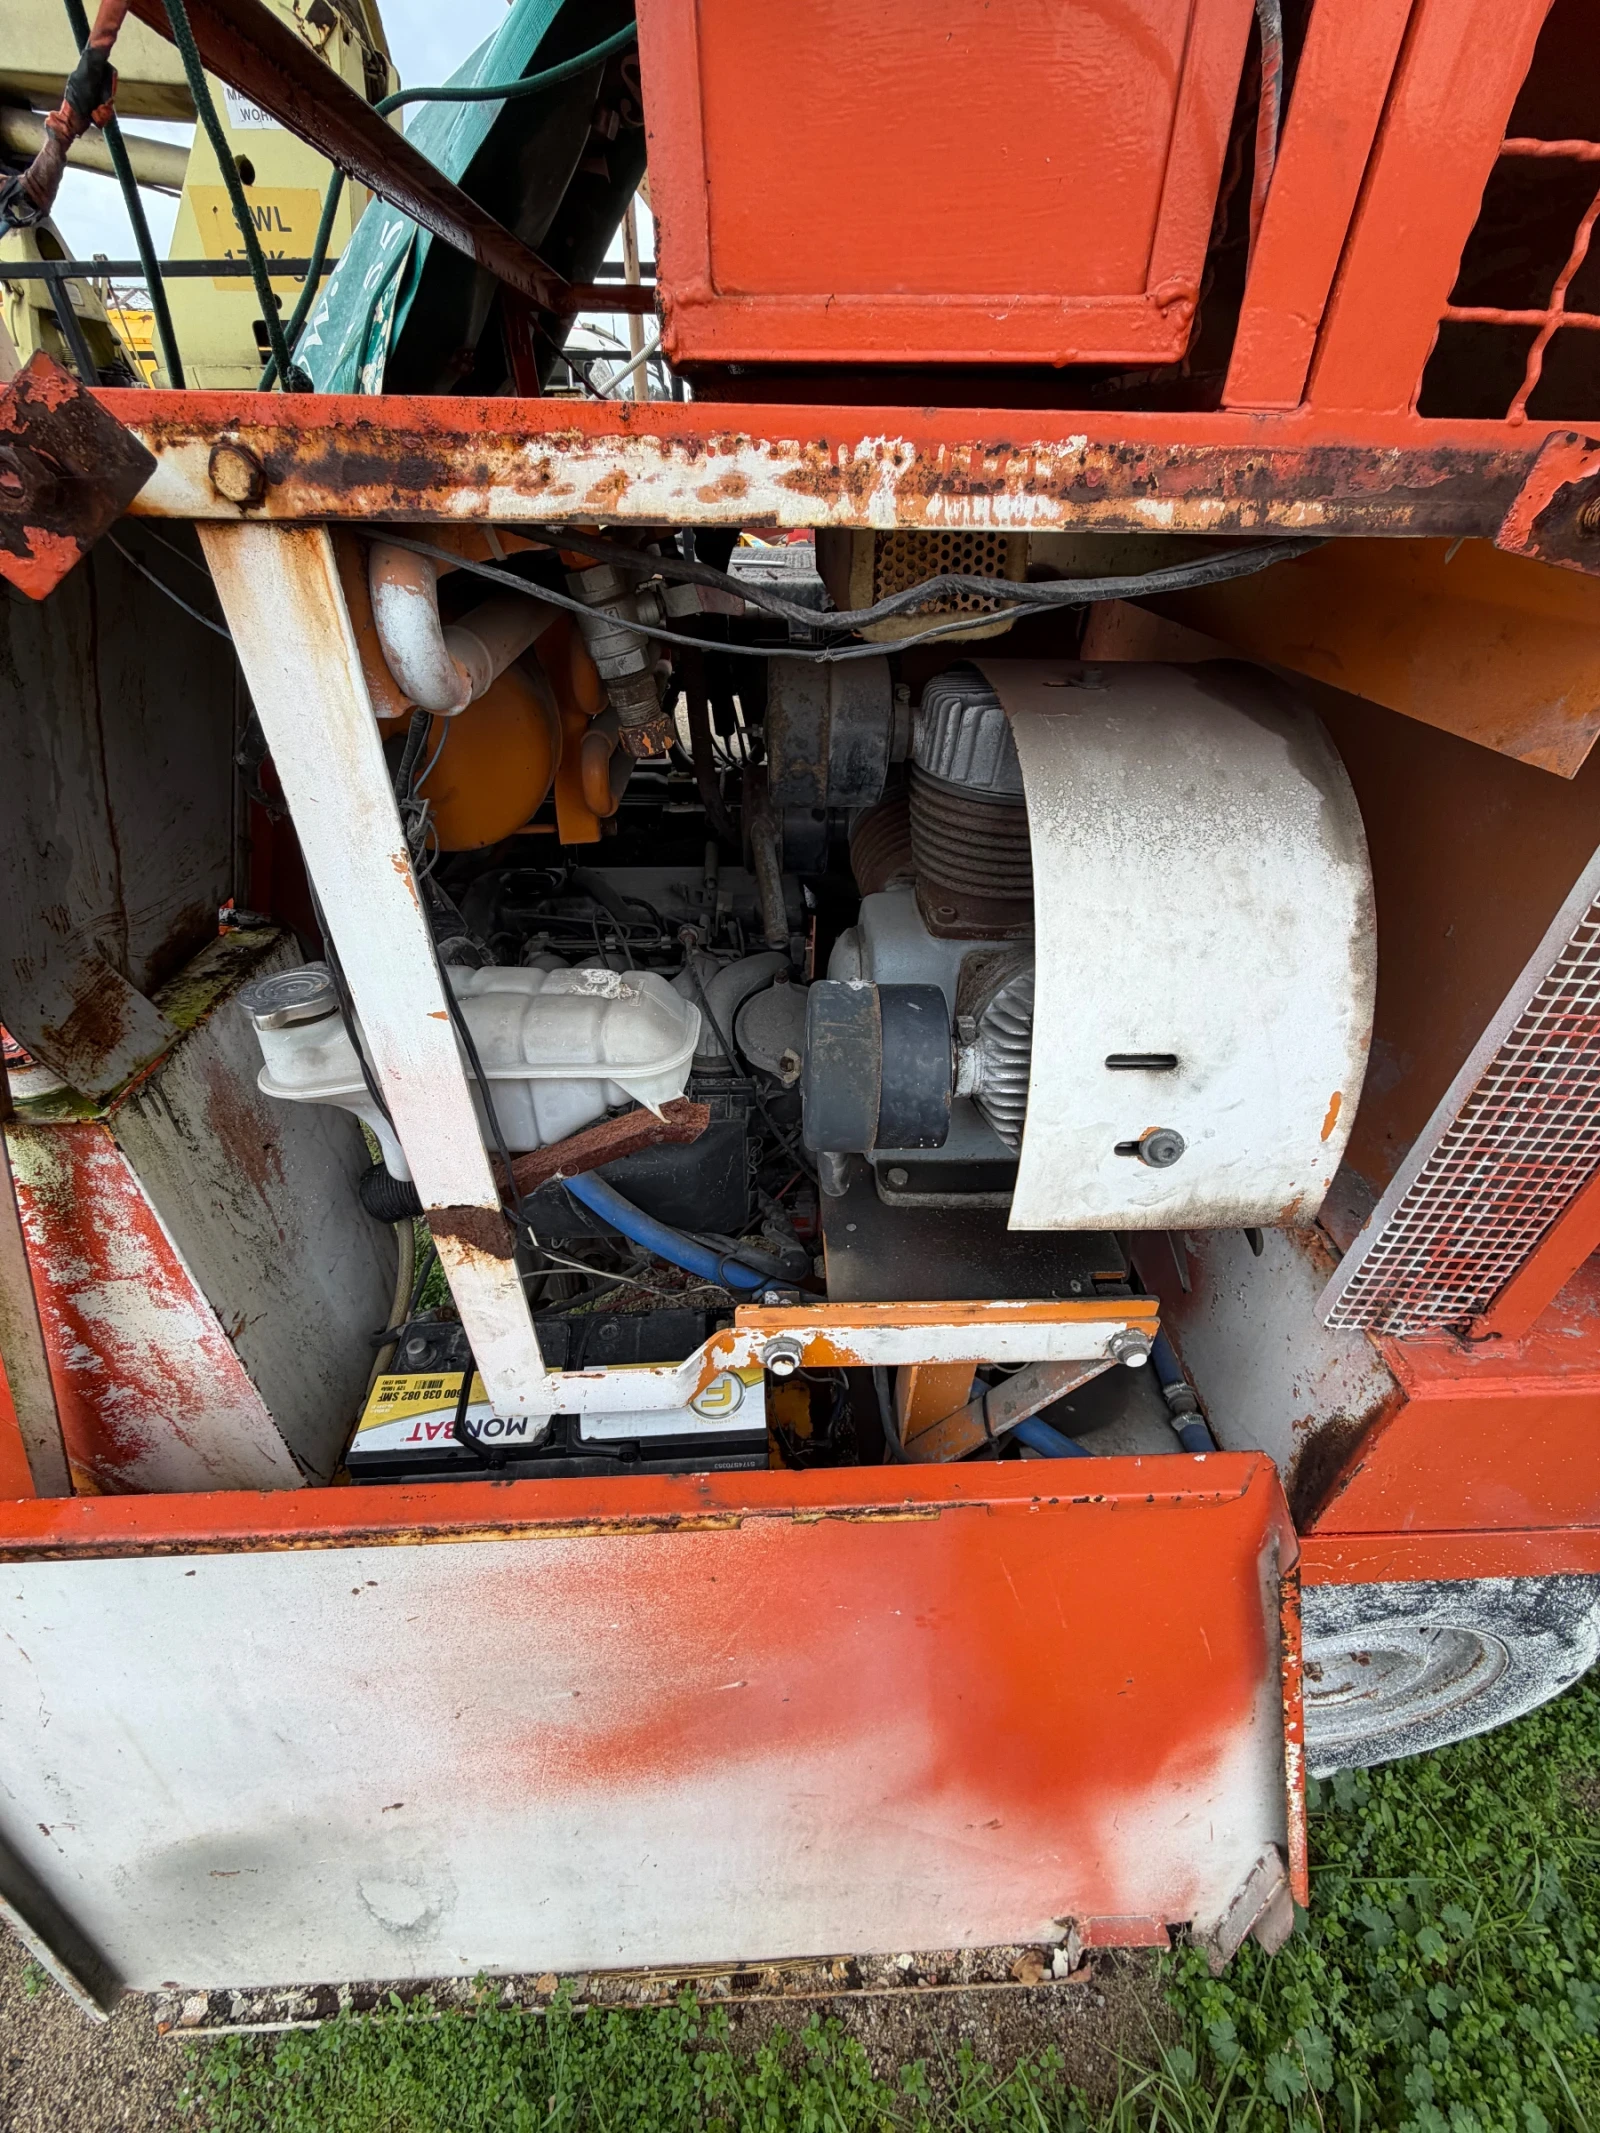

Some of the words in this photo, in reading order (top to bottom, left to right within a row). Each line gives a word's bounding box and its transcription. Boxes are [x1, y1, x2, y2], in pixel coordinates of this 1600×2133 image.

[231, 205, 292, 233] WL
[377, 1391, 399, 1402] SMF
[401, 1390, 421, 1401] 082
[422, 1389, 442, 1400] 038
